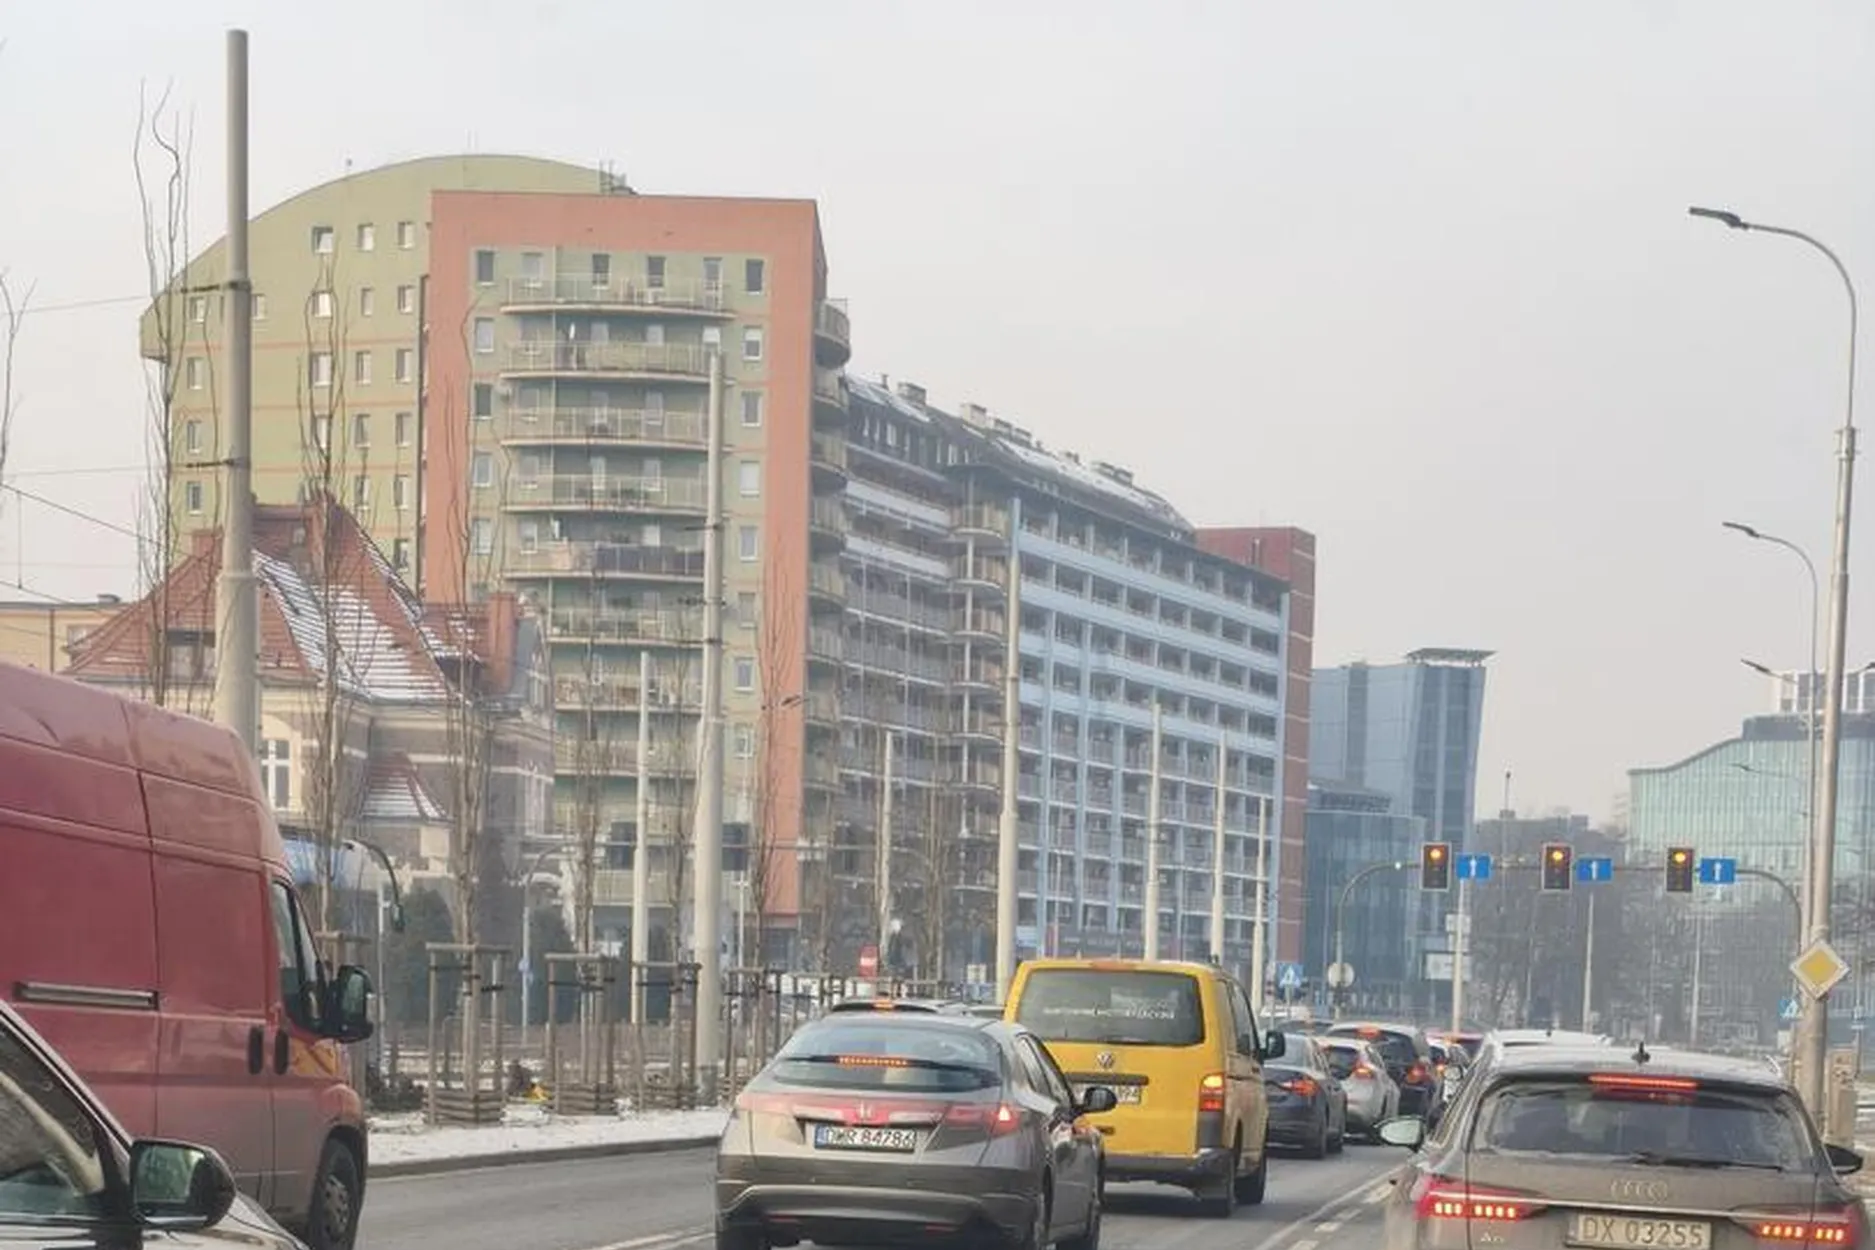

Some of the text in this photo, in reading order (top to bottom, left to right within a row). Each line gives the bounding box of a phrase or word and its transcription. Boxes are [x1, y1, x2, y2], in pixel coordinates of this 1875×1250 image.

[861, 1127, 915, 1149] 84786
[1582, 1216, 1703, 1247] DX 03255
